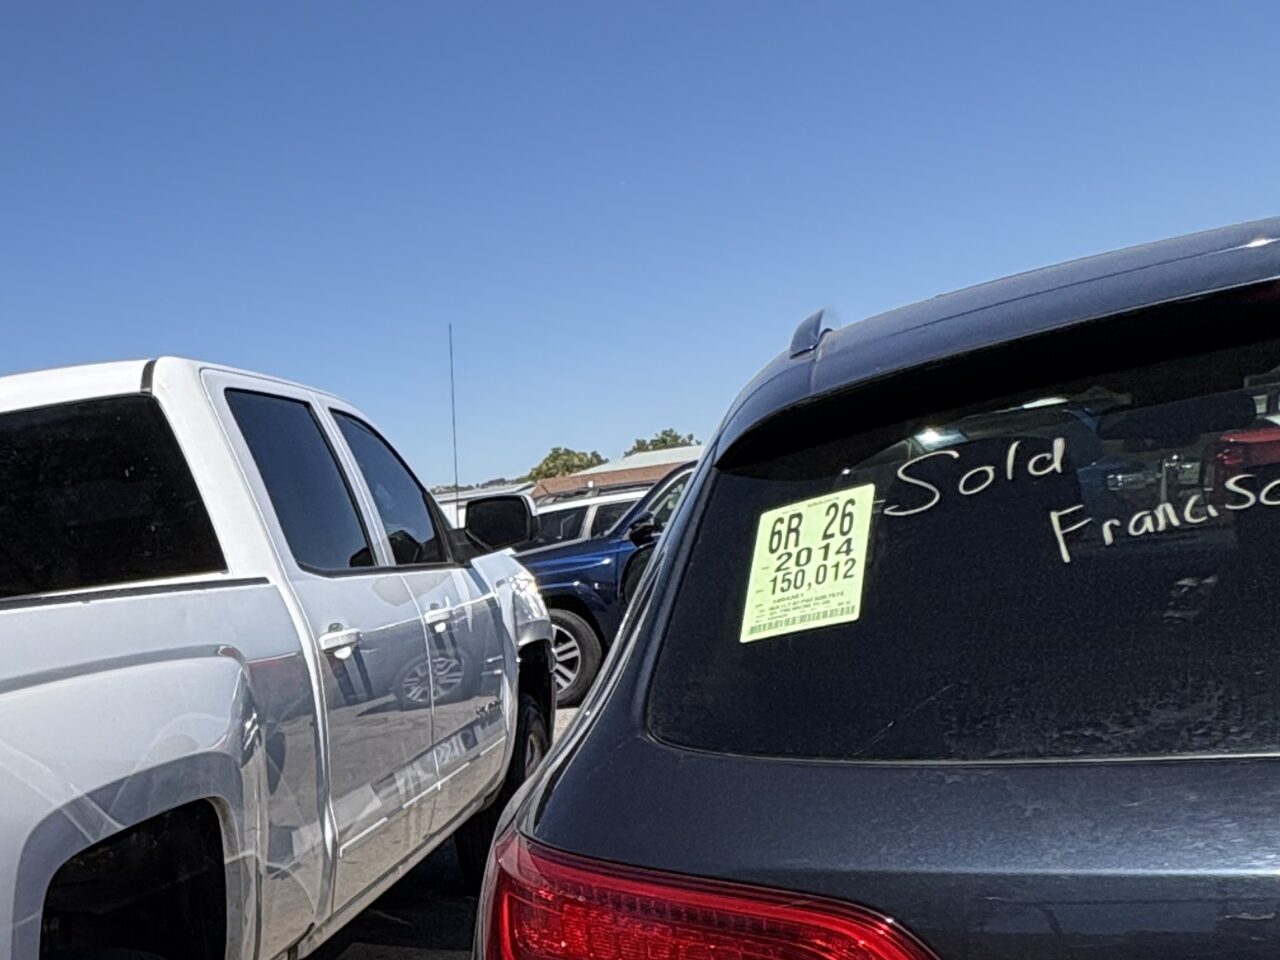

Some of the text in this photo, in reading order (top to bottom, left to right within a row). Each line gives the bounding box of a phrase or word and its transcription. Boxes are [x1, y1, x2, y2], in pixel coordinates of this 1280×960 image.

[884, 437, 1065, 517] Sold
[768, 498, 856, 555] 6R 26
[768, 557, 857, 596] 150,012
[774, 537, 855, 573] 2014
